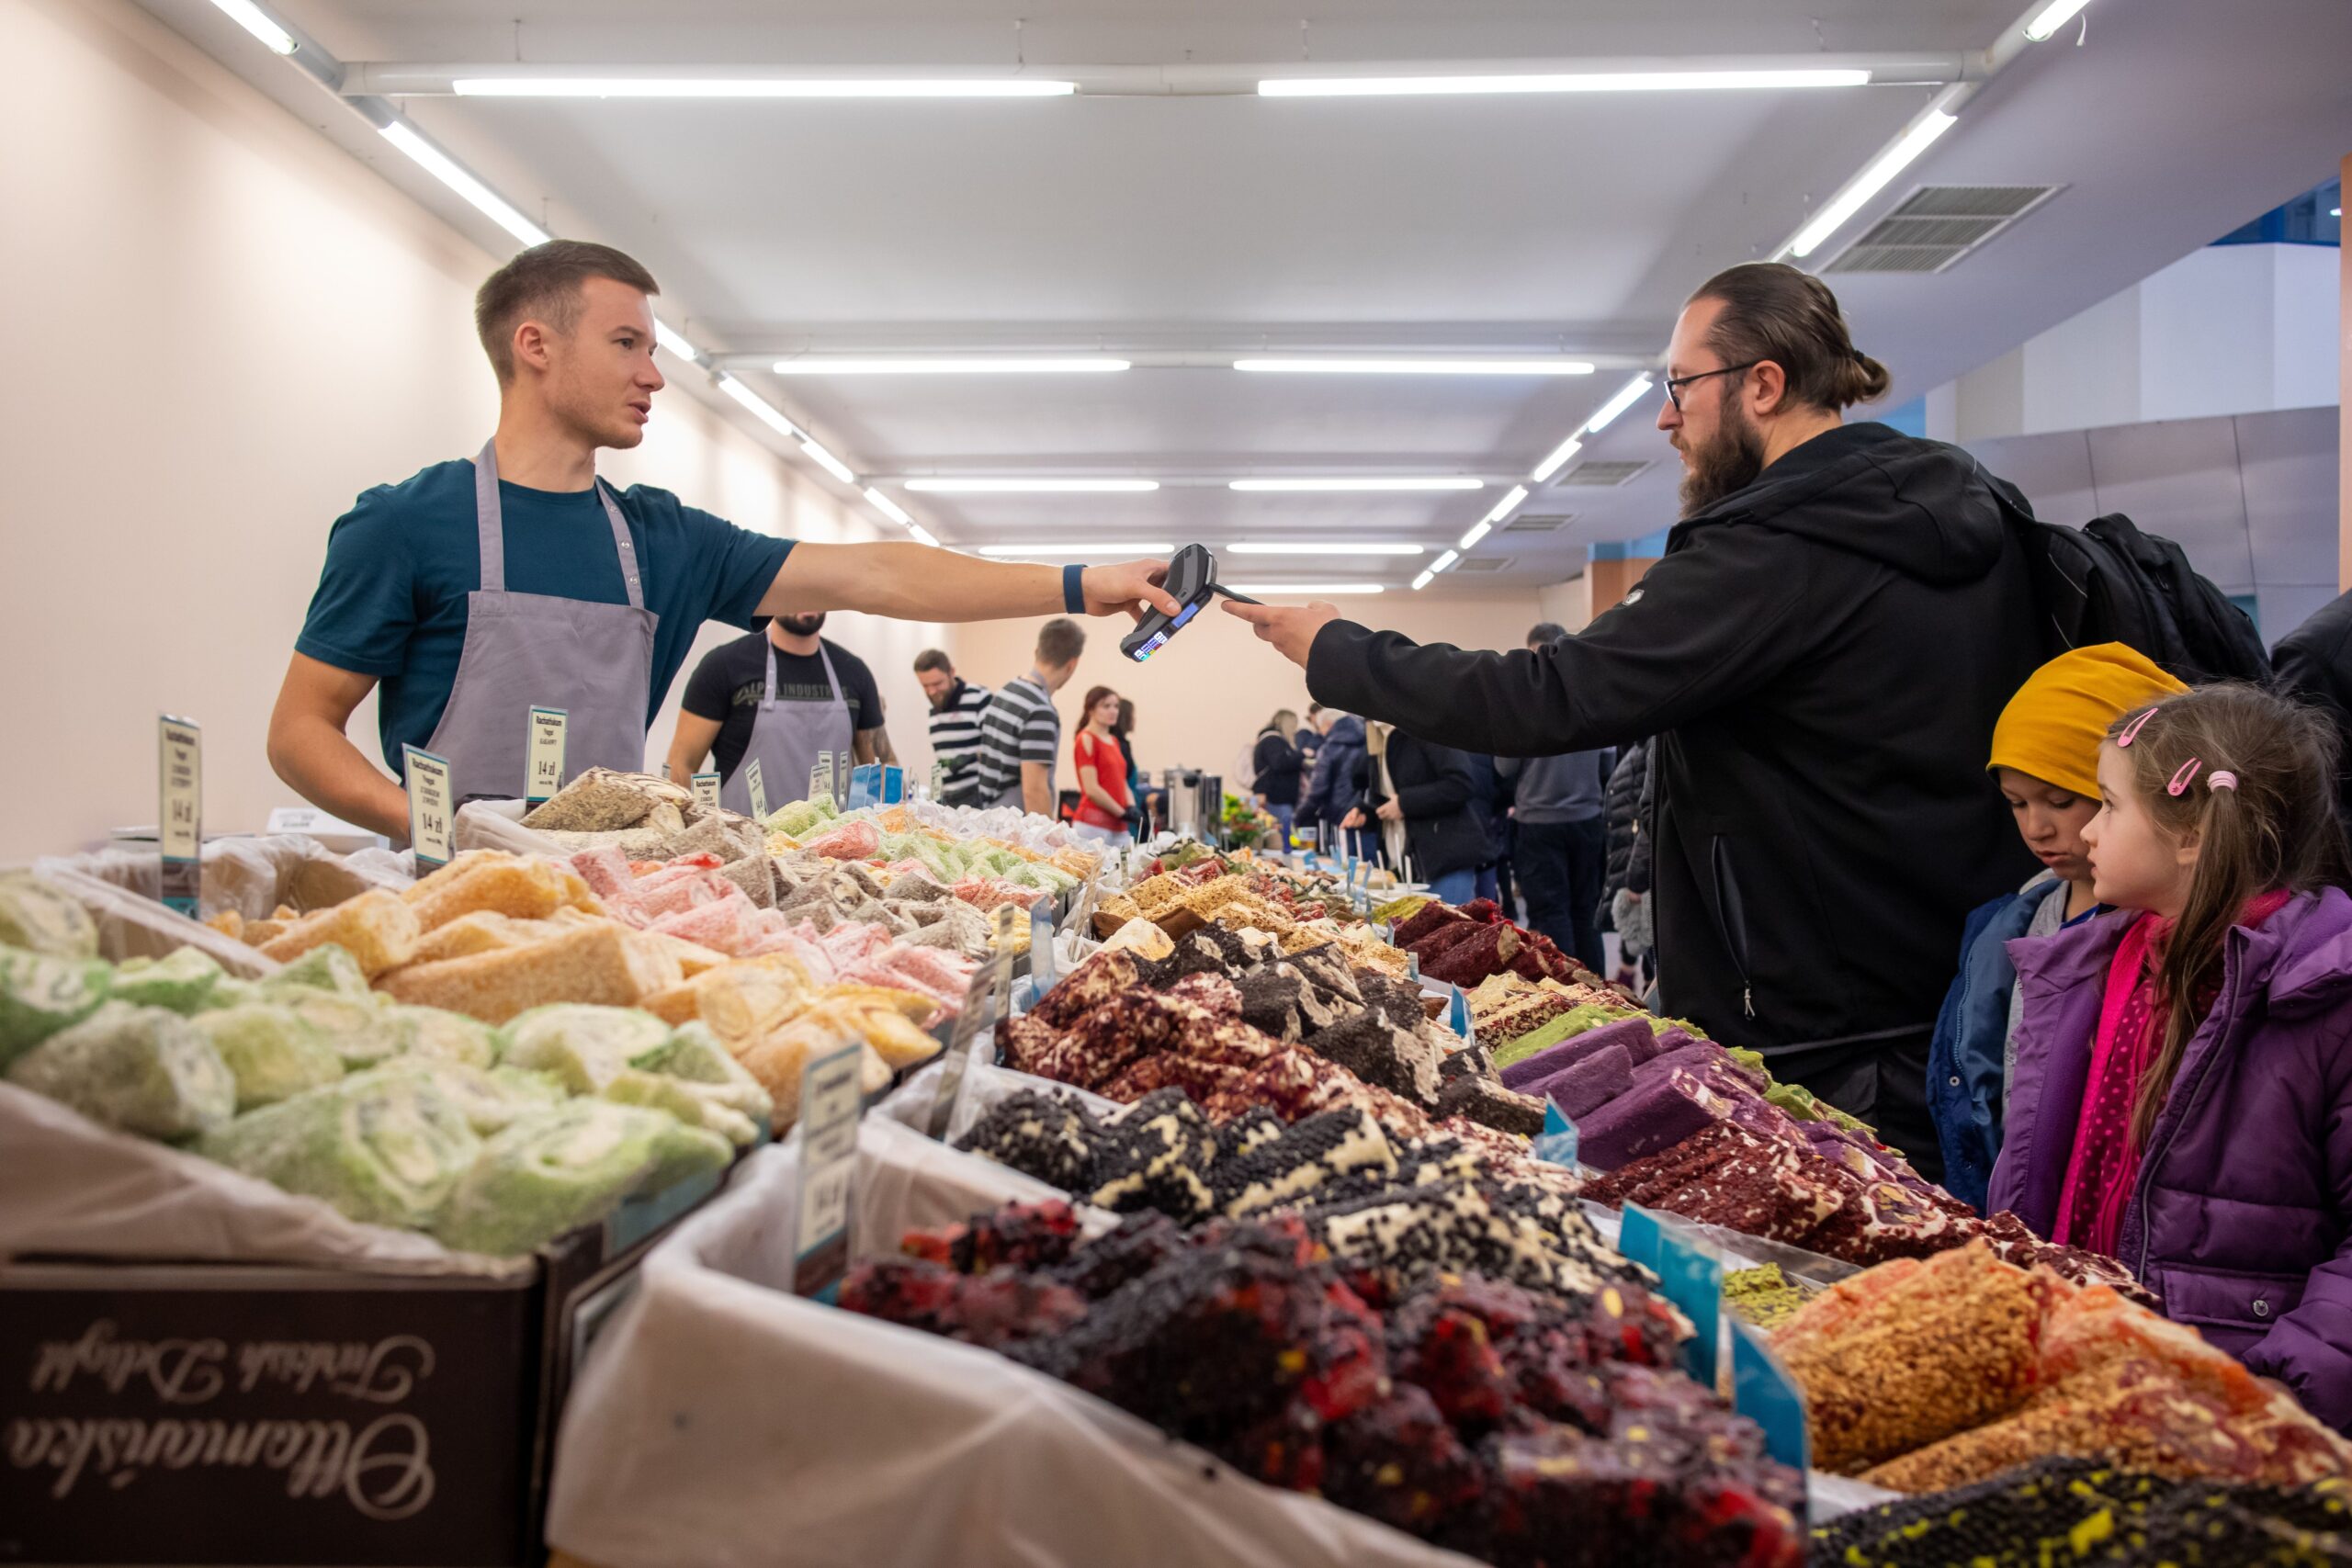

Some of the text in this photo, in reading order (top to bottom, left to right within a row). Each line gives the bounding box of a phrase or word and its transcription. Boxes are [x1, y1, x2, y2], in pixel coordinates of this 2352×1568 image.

[783, 682, 849, 698] INDUSTRS
[538, 761, 548, 775] 14
[423, 813, 433, 830] 14
[30, 1318, 435, 1404] Turkish Delight
